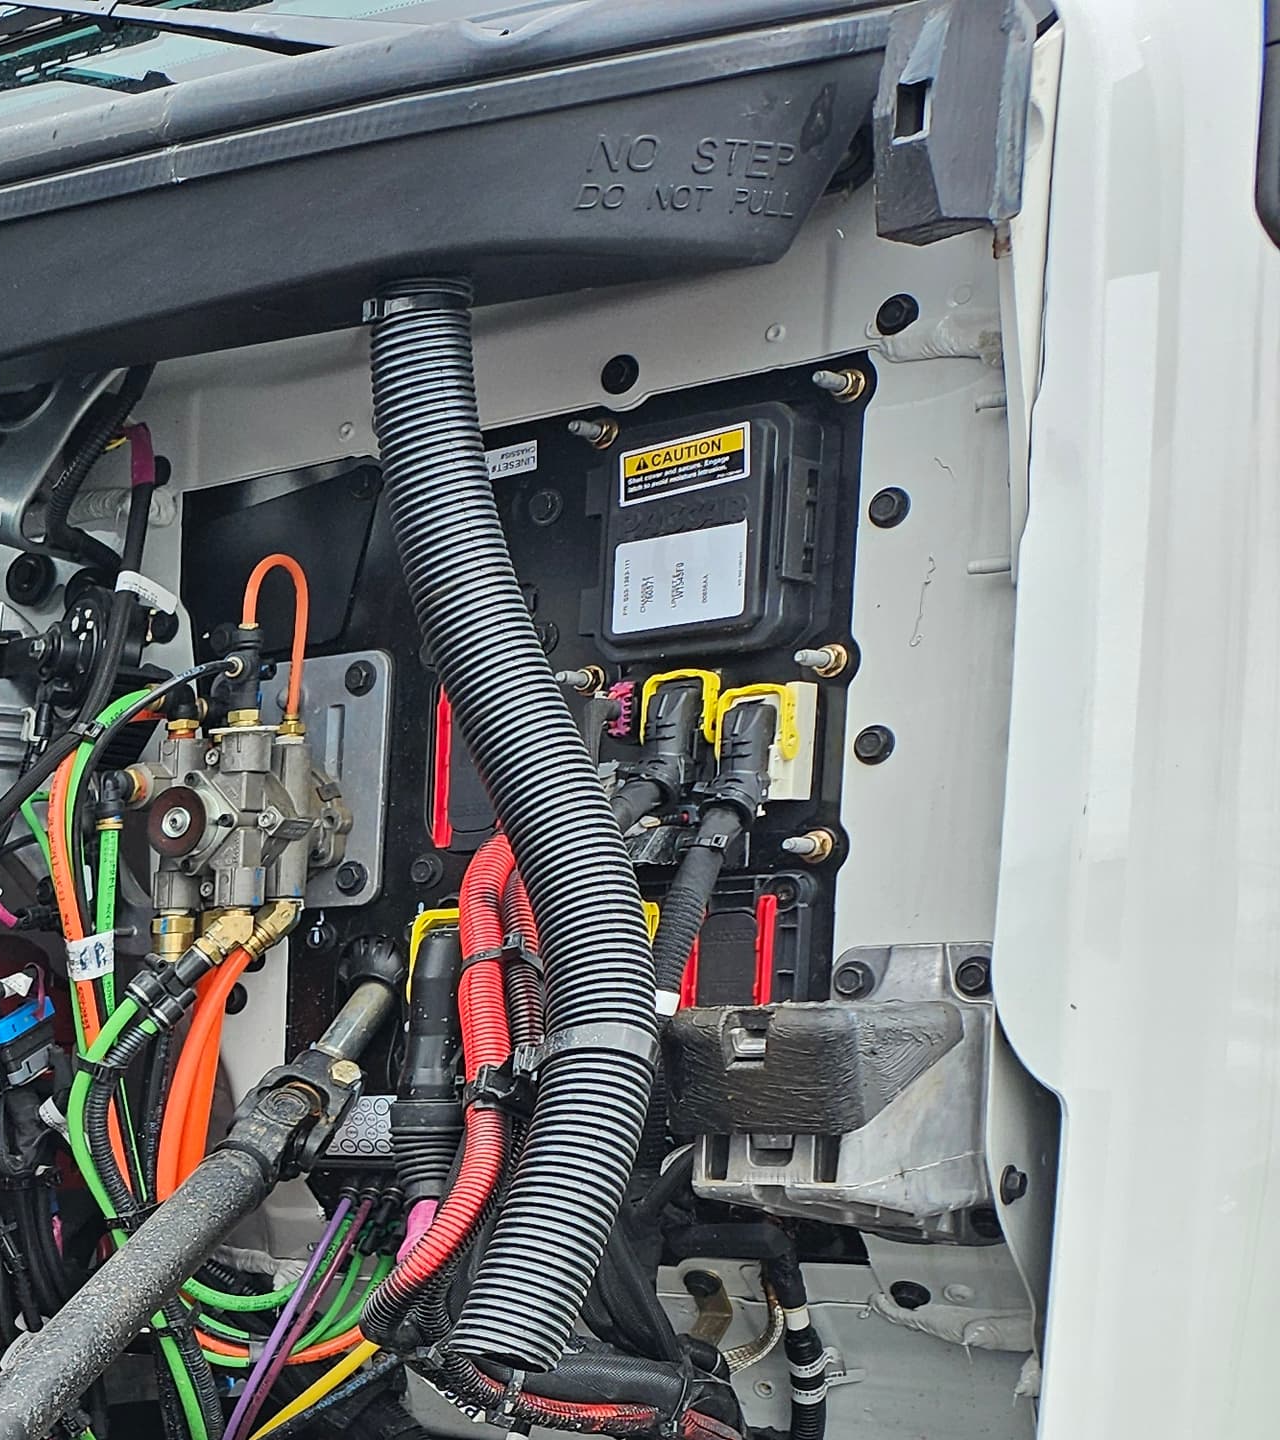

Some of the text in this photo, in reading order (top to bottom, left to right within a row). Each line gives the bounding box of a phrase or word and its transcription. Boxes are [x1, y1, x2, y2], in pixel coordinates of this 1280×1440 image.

[586, 131, 795, 180] NO STEP
[573, 183, 795, 218] DO NOT PULL
[651, 438, 722, 467] CAUTION
